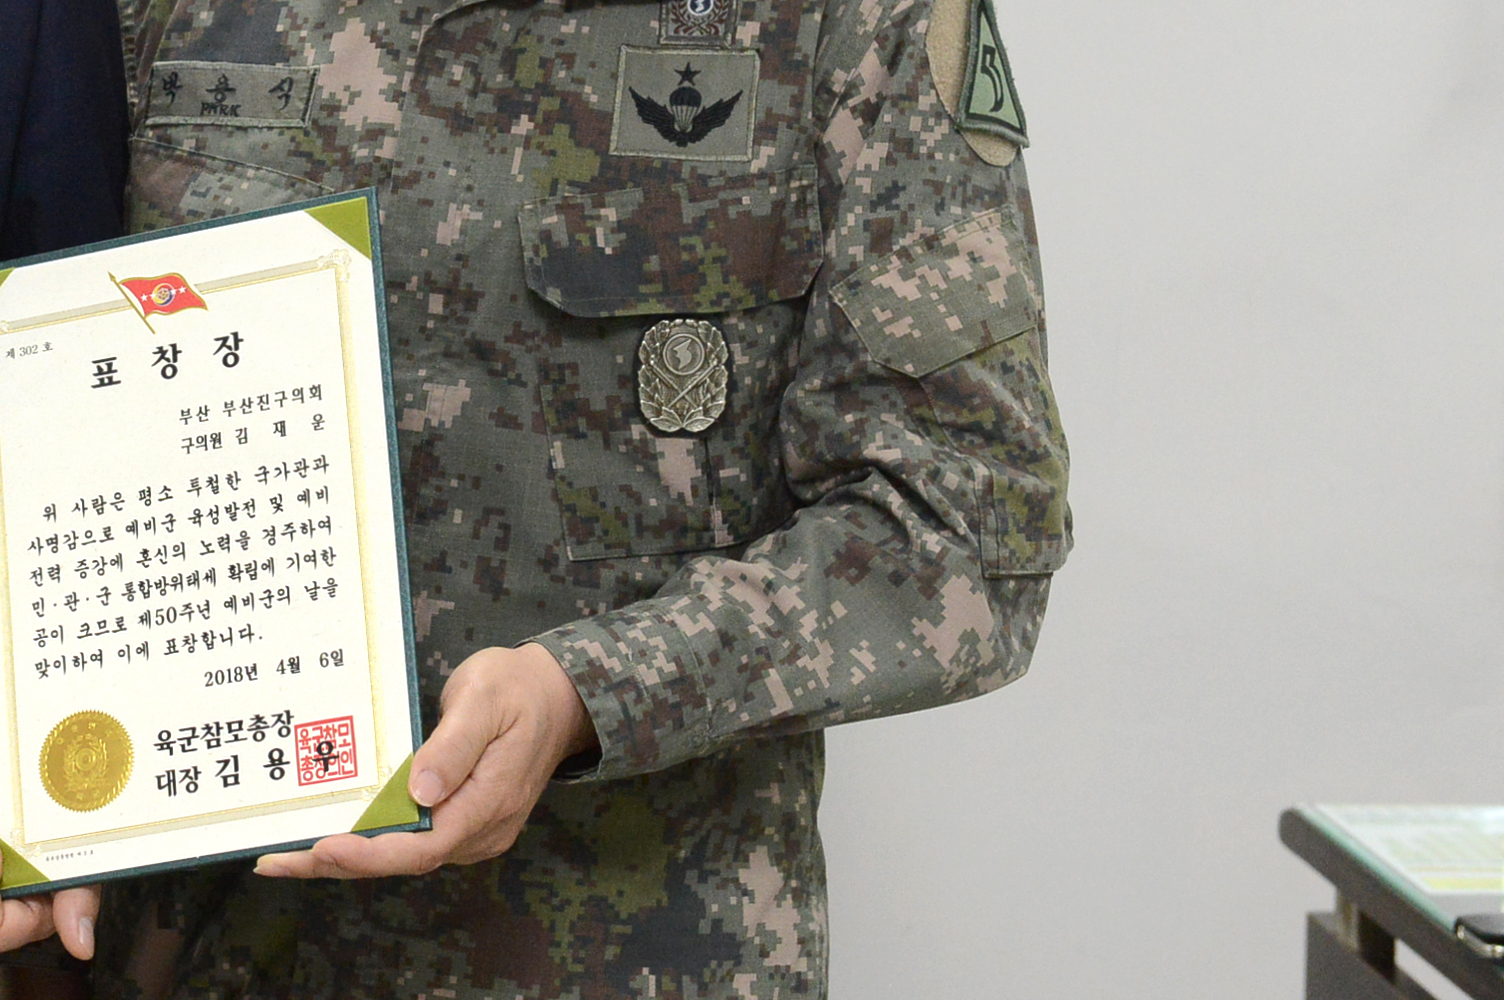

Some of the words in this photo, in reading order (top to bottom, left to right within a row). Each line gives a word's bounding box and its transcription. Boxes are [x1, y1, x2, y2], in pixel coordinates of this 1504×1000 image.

[200, 102, 242, 117] PARK
[5, 347, 16, 359] 제
[19, 344, 39, 357] 302
[42, 341, 53, 352] 호
[179, 404, 210, 426] 부산
[222, 383, 323, 421] 부산진구의회
[181, 431, 223, 455] 구의원
[234, 427, 248, 445] 김
[272, 420, 287, 438] 재
[42, 503, 57, 522] 위
[72, 491, 126, 518] 사람은
[138, 485, 174, 507] 평소
[186, 470, 242, 497] 투철한
[254, 454, 330, 485] 국가관과
[27, 525, 115, 556] 사명감으로
[125, 512, 177, 539] 예비군
[187, 498, 256, 527] 육성발전
[269, 493, 284, 514] 및
[296, 485, 329, 507] 예비
[30, 563, 61, 587] 전력
[73, 552, 123, 580] 증강에
[136, 541, 186, 569] 혼신의
[199, 530, 251, 556] 노력을
[262, 515, 332, 547] 경주하여
[121, 566, 217, 602] 통합방위태세
[227, 556, 275, 583] 확립에
[286, 546, 337, 573] 기여한
[32, 624, 64, 648] 공이
[76, 616, 128, 640] 크므로
[138, 599, 211, 629] 제50주년
[223, 585, 291, 615] 예비군의
[303, 577, 339, 602] 날을
[34, 648, 103, 679] 맞이하여
[117, 640, 150, 663] 이에
[163, 623, 263, 656] 표창합니다.
[204, 662, 258, 688] 2018년
[276, 655, 301, 675] 4월
[319, 648, 344, 668] 6일
[152, 709, 295, 757] 육군참모총장
[155, 765, 202, 798] 대장
[215, 754, 241, 789] 김
[262, 747, 291, 781] 용
